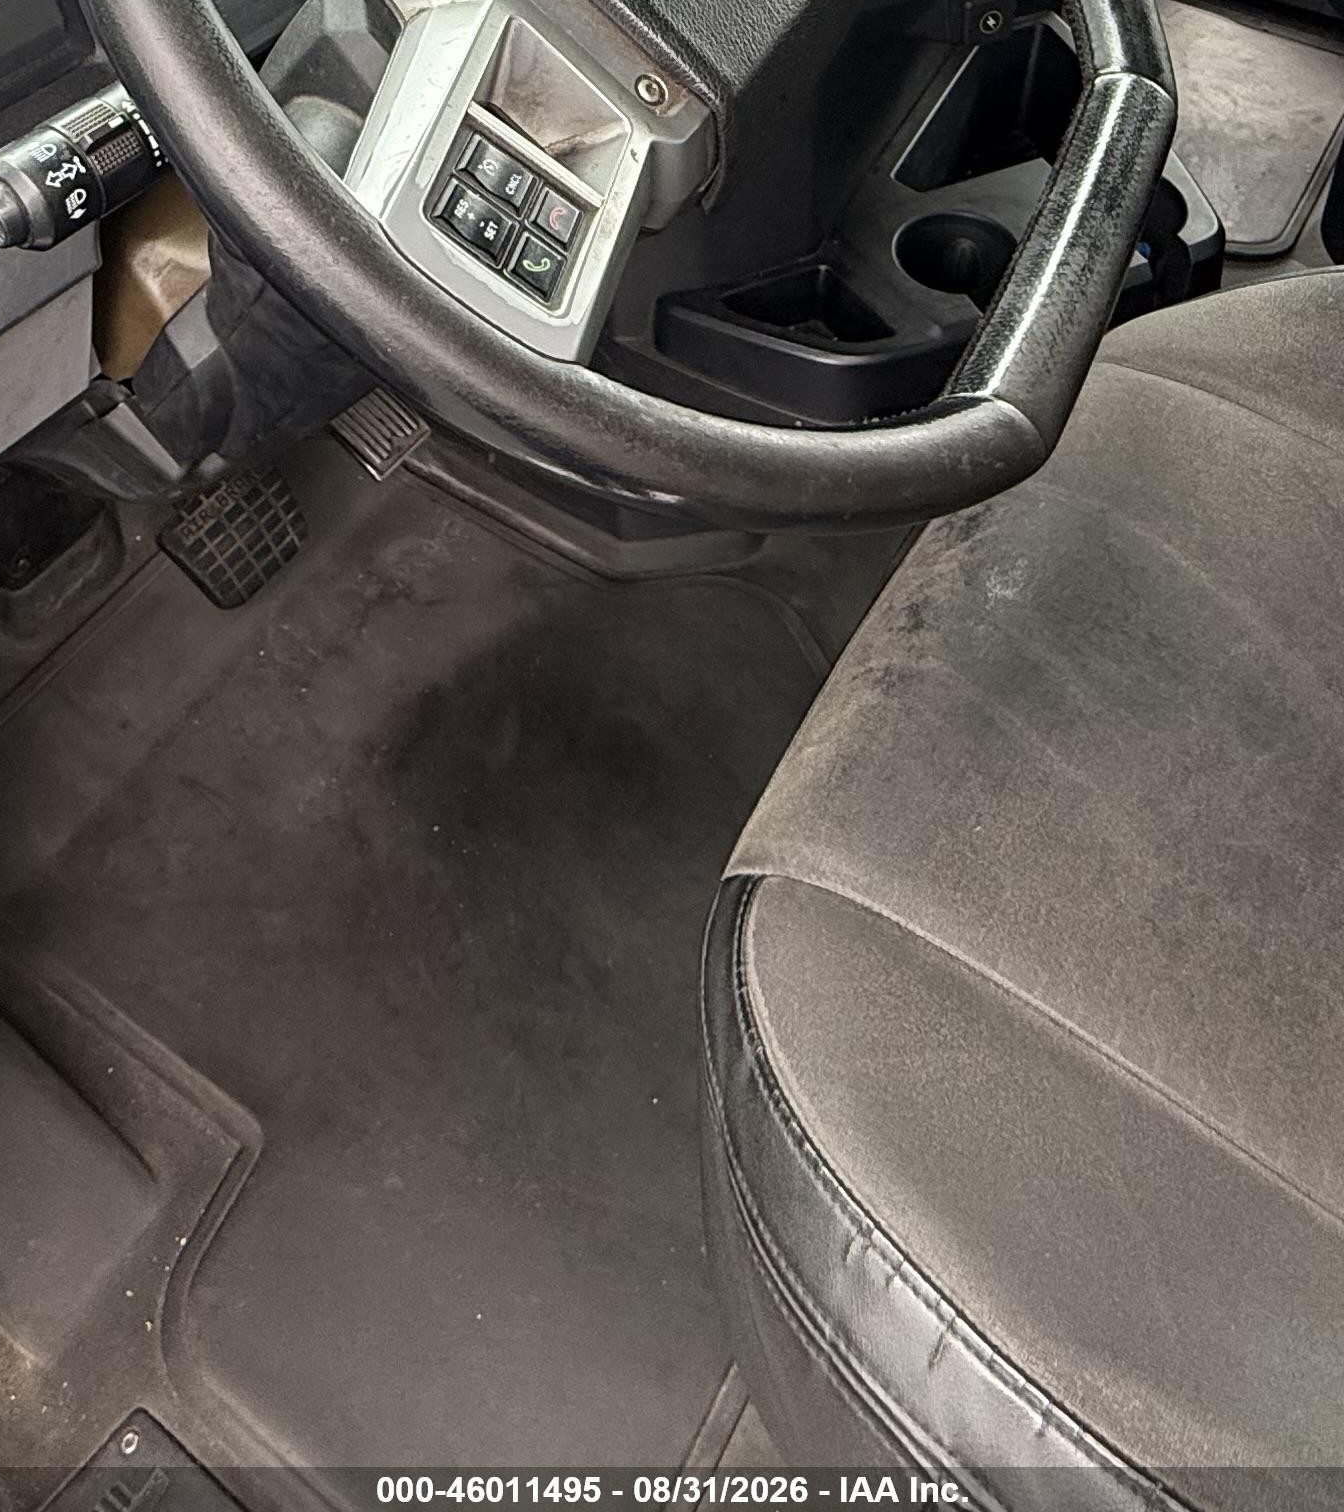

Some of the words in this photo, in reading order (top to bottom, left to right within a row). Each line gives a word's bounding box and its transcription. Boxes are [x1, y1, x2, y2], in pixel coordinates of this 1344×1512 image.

[505, 174, 522, 195] CNCL
[454, 200, 469, 219] RES
[484, 221, 500, 240] SET
